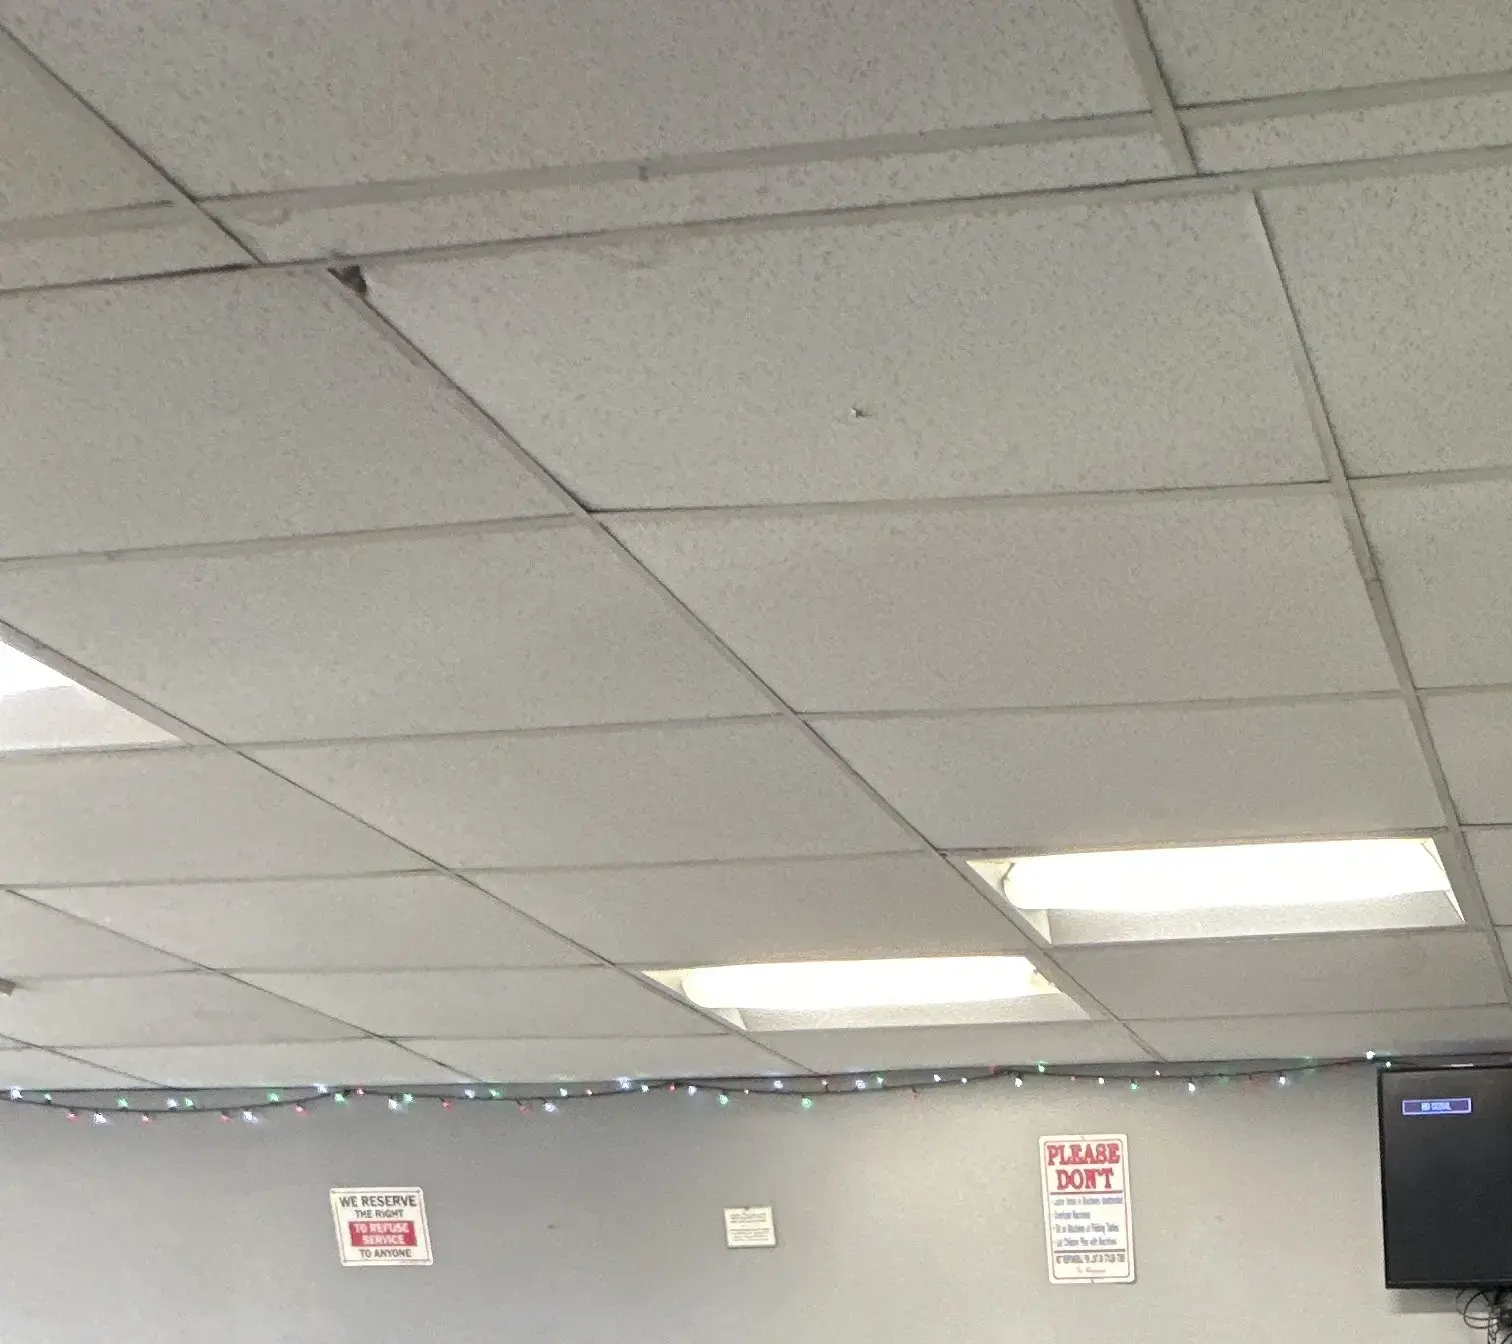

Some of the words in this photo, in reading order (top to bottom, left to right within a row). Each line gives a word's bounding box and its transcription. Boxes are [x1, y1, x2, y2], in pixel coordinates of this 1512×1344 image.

[1047, 1143, 1121, 1166] PLEASE
[1055, 1167, 1114, 1190] DON'T
[339, 1195, 358, 1208] WE
[361, 1195, 417, 1207] RESERVE
[354, 1209, 373, 1218] THE
[375, 1209, 404, 1218] RIGHT
[359, 1249, 372, 1258] TO
[374, 1248, 412, 1258] ANYONE
